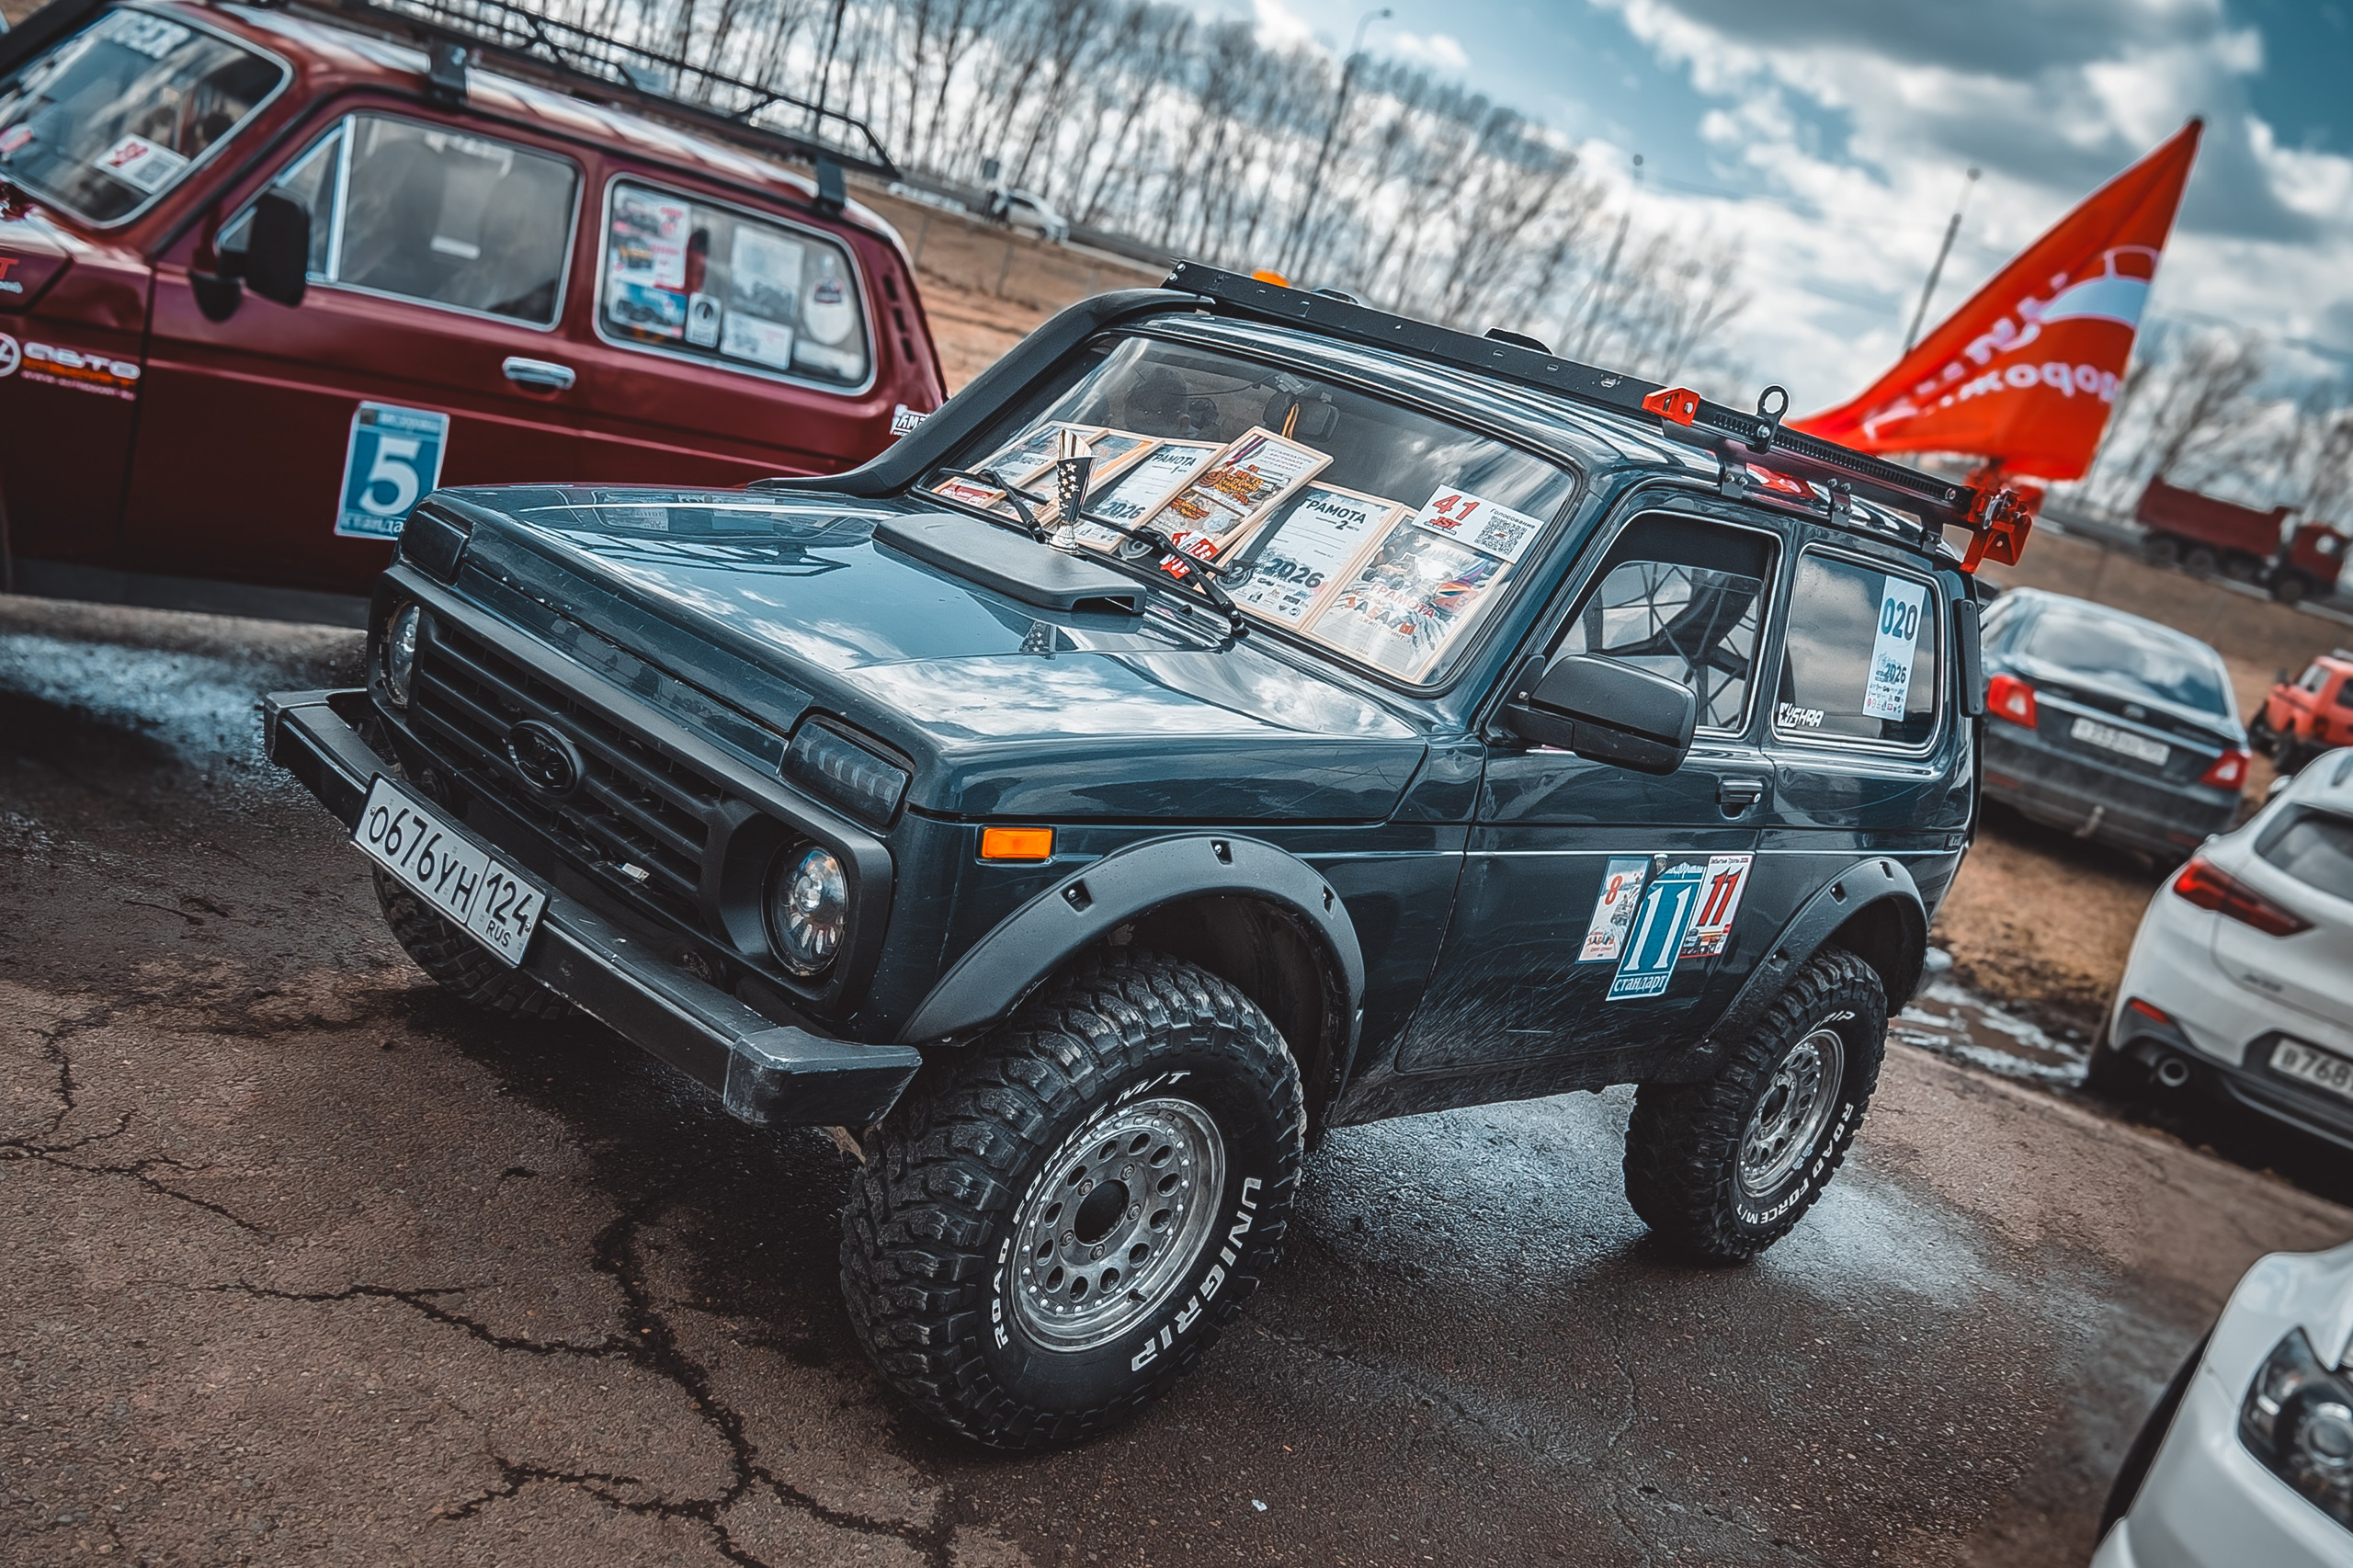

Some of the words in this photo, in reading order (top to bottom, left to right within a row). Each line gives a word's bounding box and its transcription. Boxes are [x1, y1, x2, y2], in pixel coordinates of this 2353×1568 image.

[358, 435, 422, 516] 5
[1235, 470, 1264, 486] МЕСТО
[1107, 501, 1146, 519] 2026
[1299, 498, 1368, 524] ГРАМОТА
[1429, 516, 1462, 530] JST
[1432, 494, 1481, 521] 41
[1489, 507, 1536, 529] Голосование
[1335, 520, 1348, 530] 2
[1267, 557, 1325, 589] 2026
[1345, 597, 1416, 636] ЗАБАВЫ
[1370, 583, 1436, 619] ГРАМОТА
[1456, 595, 1469, 608] 3
[1358, 615, 1379, 629] ДЖИП
[1380, 624, 1405, 641] СПРИНТ
[1881, 597, 1918, 642] 020
[1884, 663, 1907, 684] 2026
[486, 872, 533, 937] 124
[1604, 875, 1623, 905] 8
[1695, 865, 1745, 927] 11
[485, 919, 512, 949] RUS
[1623, 885, 1693, 971] 11
[1812, 1102, 1855, 1179] ROAD
[991, 1237, 1010, 1350] ROAD
[1114, 1071, 1191, 1106] M/T
[1760, 1177, 1809, 1224] FORCE
[1131, 1177, 1262, 1371] UNIGRIP
